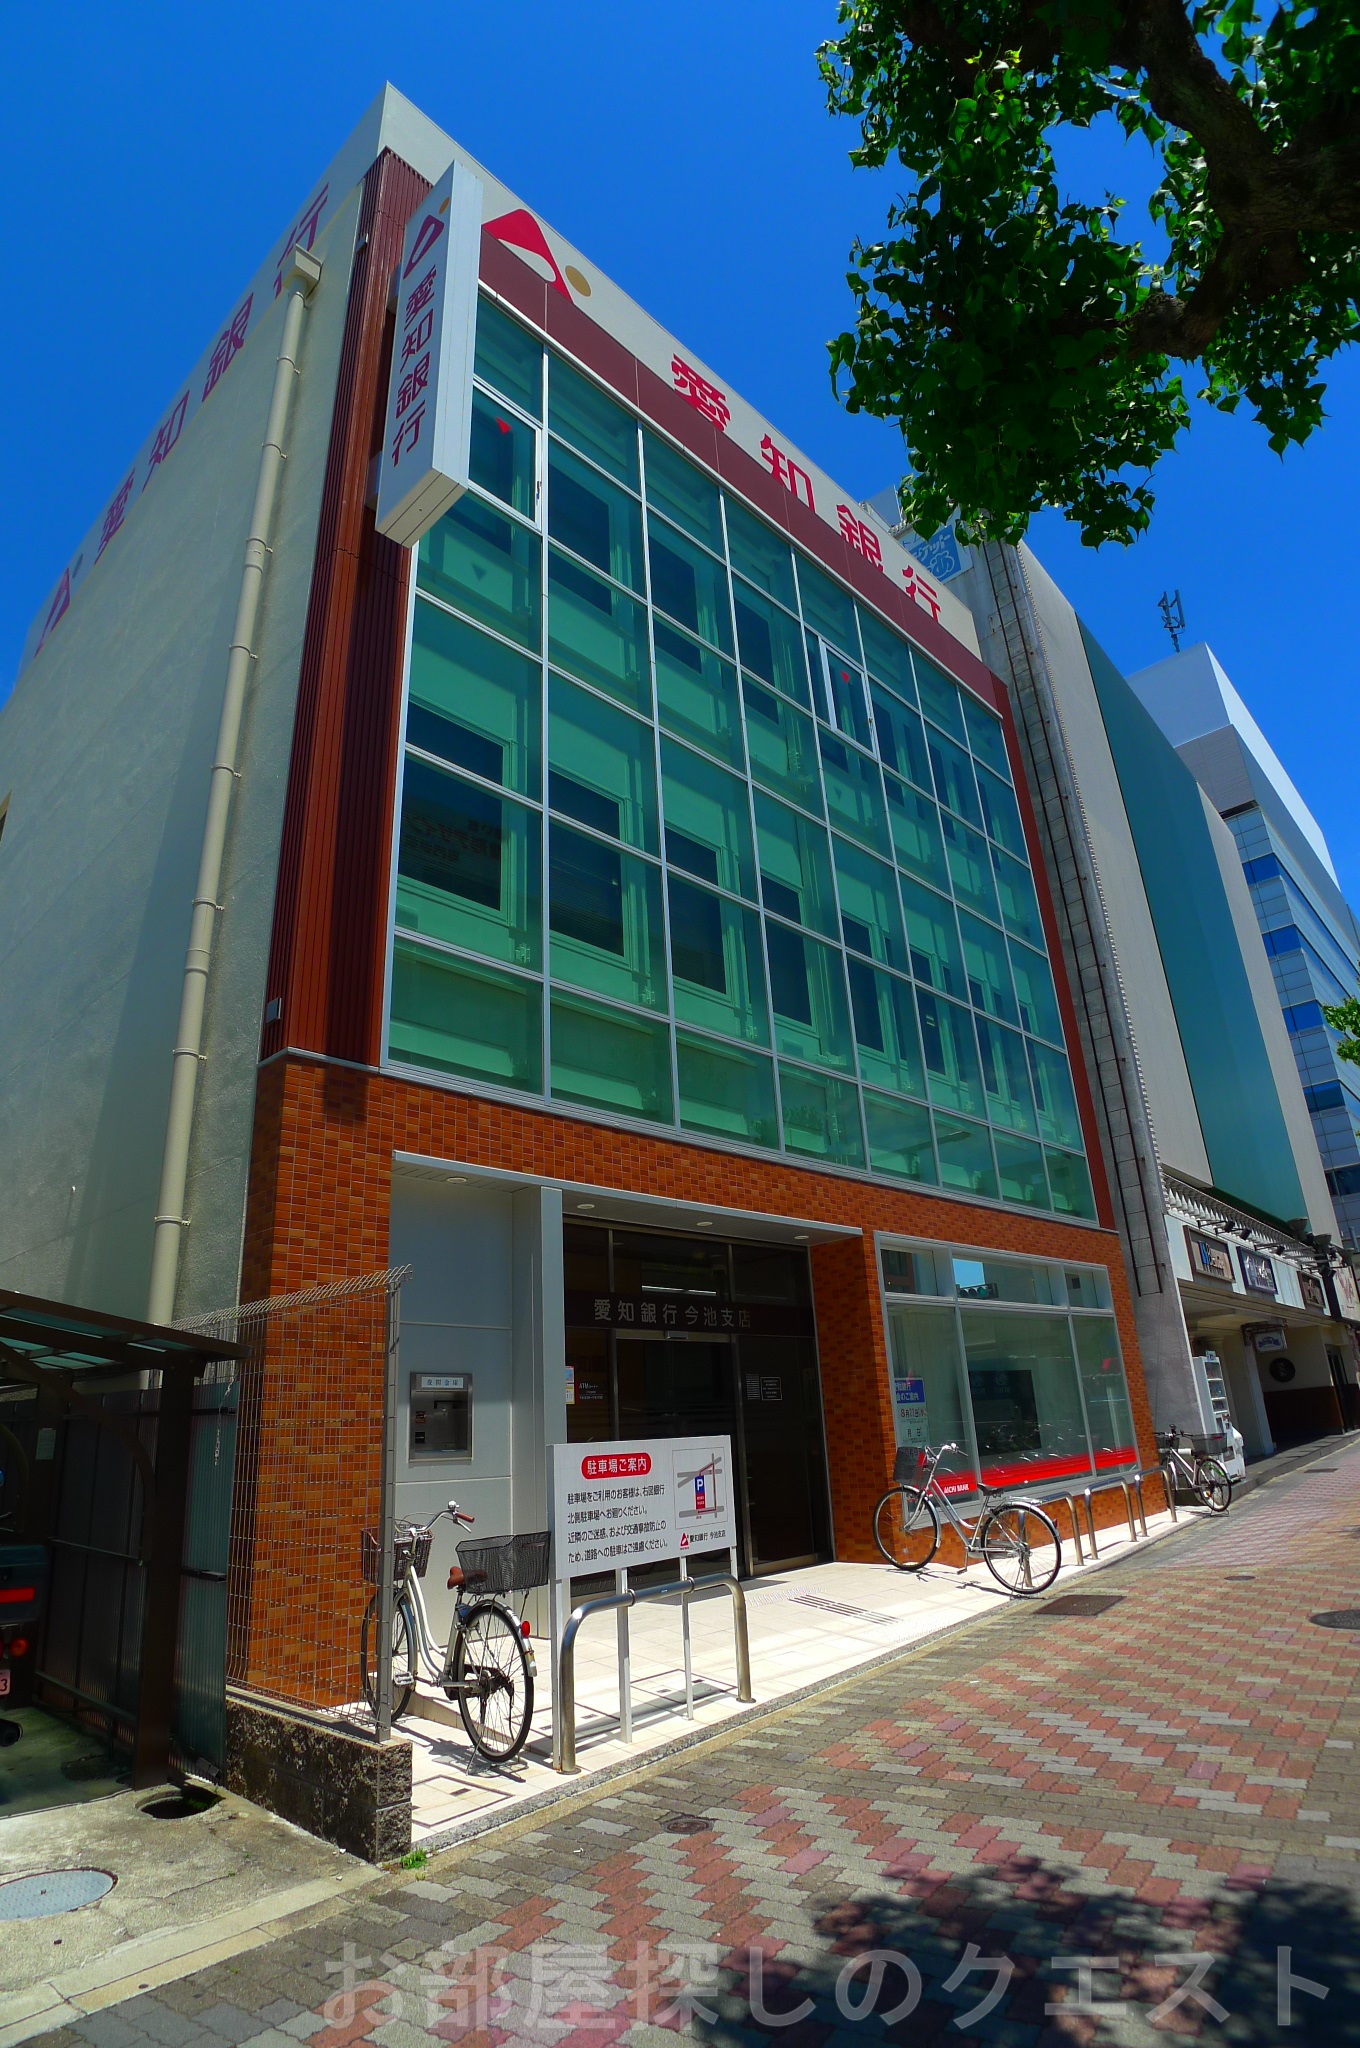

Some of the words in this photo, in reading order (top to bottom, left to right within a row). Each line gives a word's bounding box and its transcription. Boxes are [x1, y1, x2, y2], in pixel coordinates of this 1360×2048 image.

[393, 264, 437, 467] 愛知銀行
[671, 353, 941, 623] 愛知銀行
[594, 1298, 750, 1329] 愛知銀行今池支店
[587, 1457, 647, 1475] 駐車場ご案内
[697, 1479, 703, 1491] P
